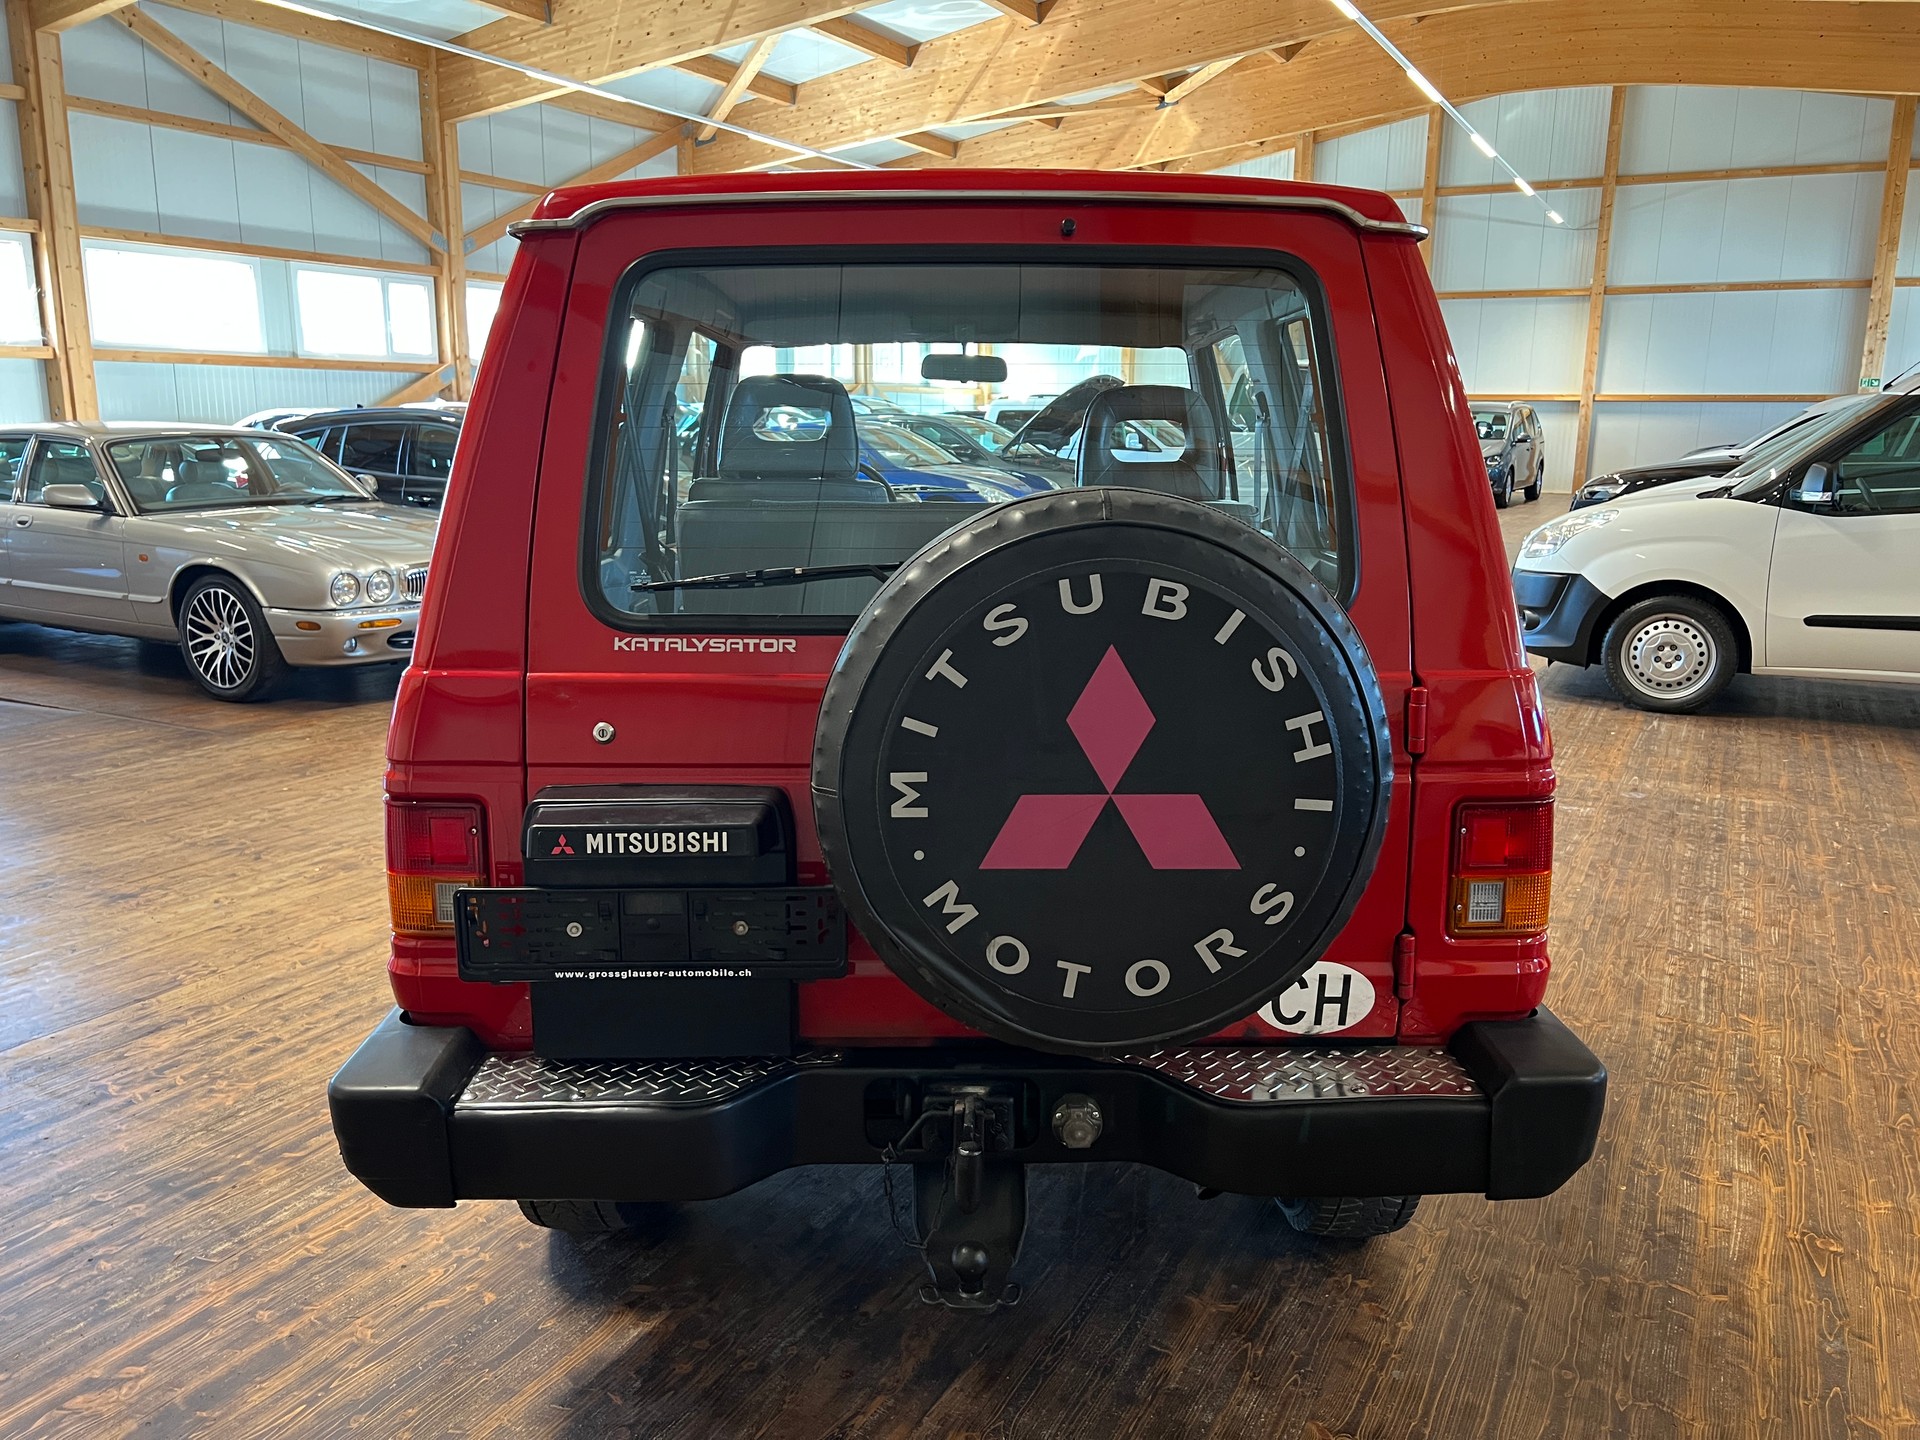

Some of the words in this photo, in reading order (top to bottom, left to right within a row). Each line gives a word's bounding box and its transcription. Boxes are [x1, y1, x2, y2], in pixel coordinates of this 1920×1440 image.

[613, 636, 797, 653] KATALYSATOR
[890, 572, 1334, 818] MITSUBISHI
[586, 831, 728, 854] MITSUBISHI
[922, 879, 1296, 999] MOTORS
[554, 968, 752, 980] www.grossglauser-automobile.ch
[1270, 973, 1352, 1026] CH
